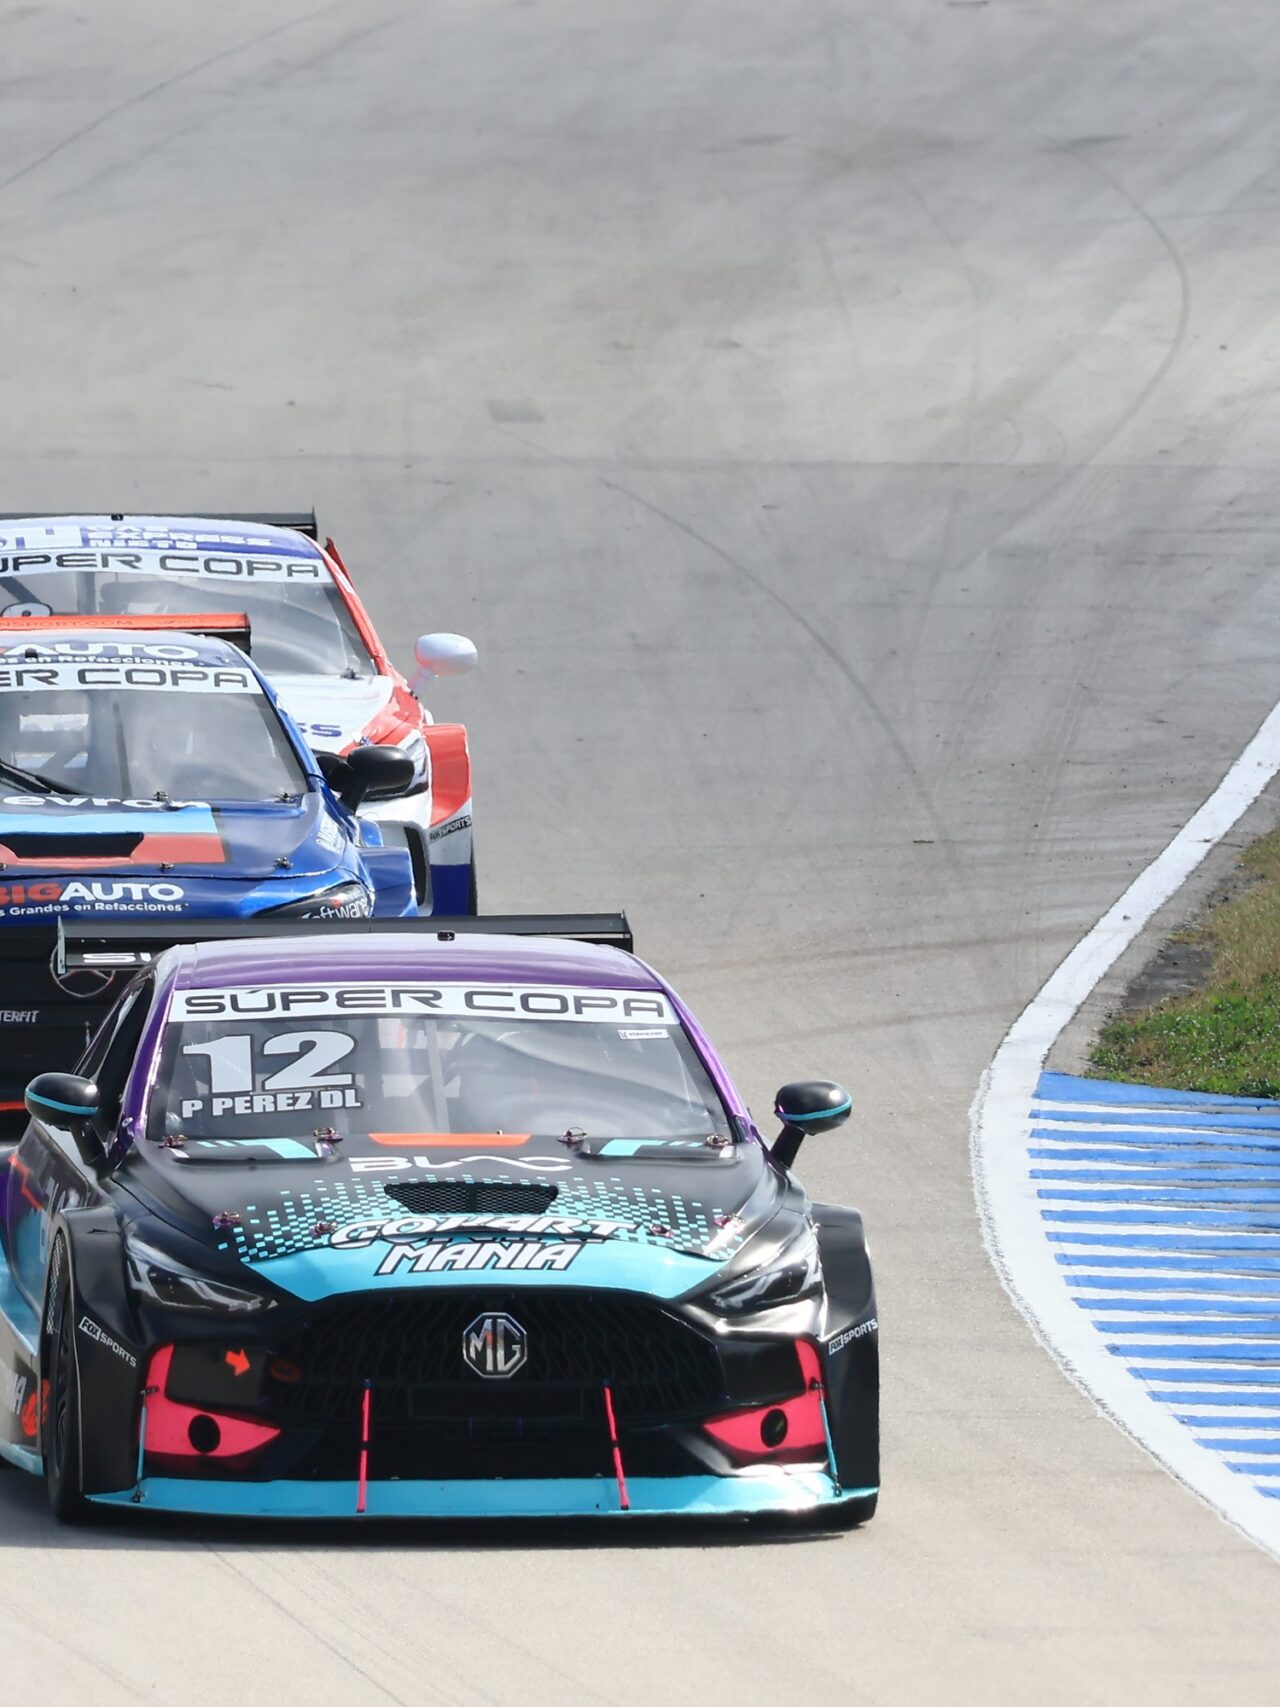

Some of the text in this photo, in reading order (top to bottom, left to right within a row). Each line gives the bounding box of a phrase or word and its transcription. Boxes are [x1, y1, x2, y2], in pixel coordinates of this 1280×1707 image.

[159, 556, 319, 578] COPA
[24, 656, 45, 664] en
[78, 668, 249, 688] COPA
[9, 903, 70, 916] Grandes
[74, 902, 91, 911] en
[95, 897, 182, 912] Refacciones
[185, 988, 665, 1018] SÚPER COPA
[182, 1030, 356, 1095] 12
[182, 1088, 362, 1118] P PEREZ DL
[373, 1240, 582, 1277] MANIA
[79, 1315, 137, 1368] FOX SPORTS
[468, 1318, 522, 1372] MG
[843, 1318, 878, 1345] SPORTS
